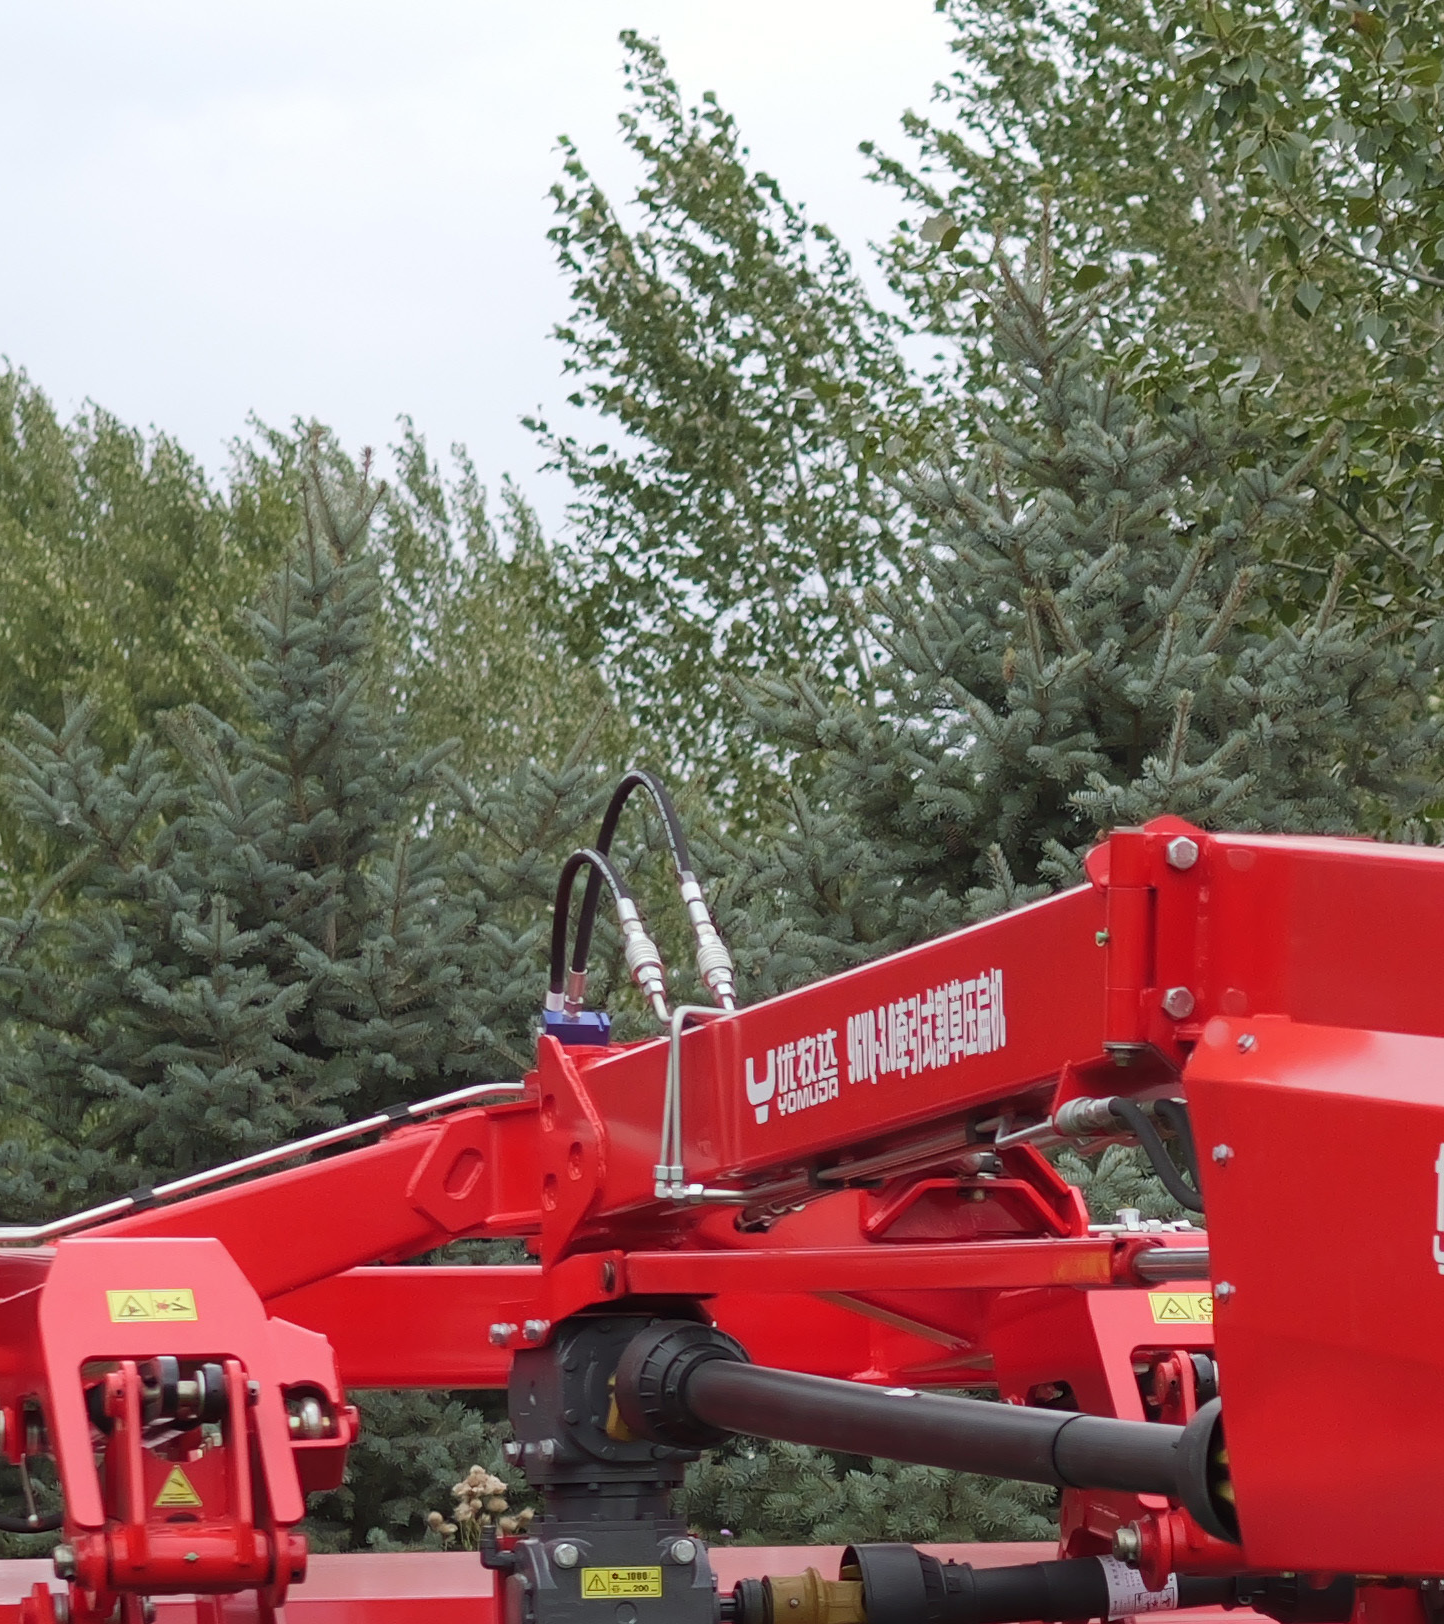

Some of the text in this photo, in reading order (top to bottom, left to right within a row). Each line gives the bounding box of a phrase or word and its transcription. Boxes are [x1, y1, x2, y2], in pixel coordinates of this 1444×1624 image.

[777, 1028, 839, 1093] 优牧达
[777, 1077, 839, 1116] YOMUDA
